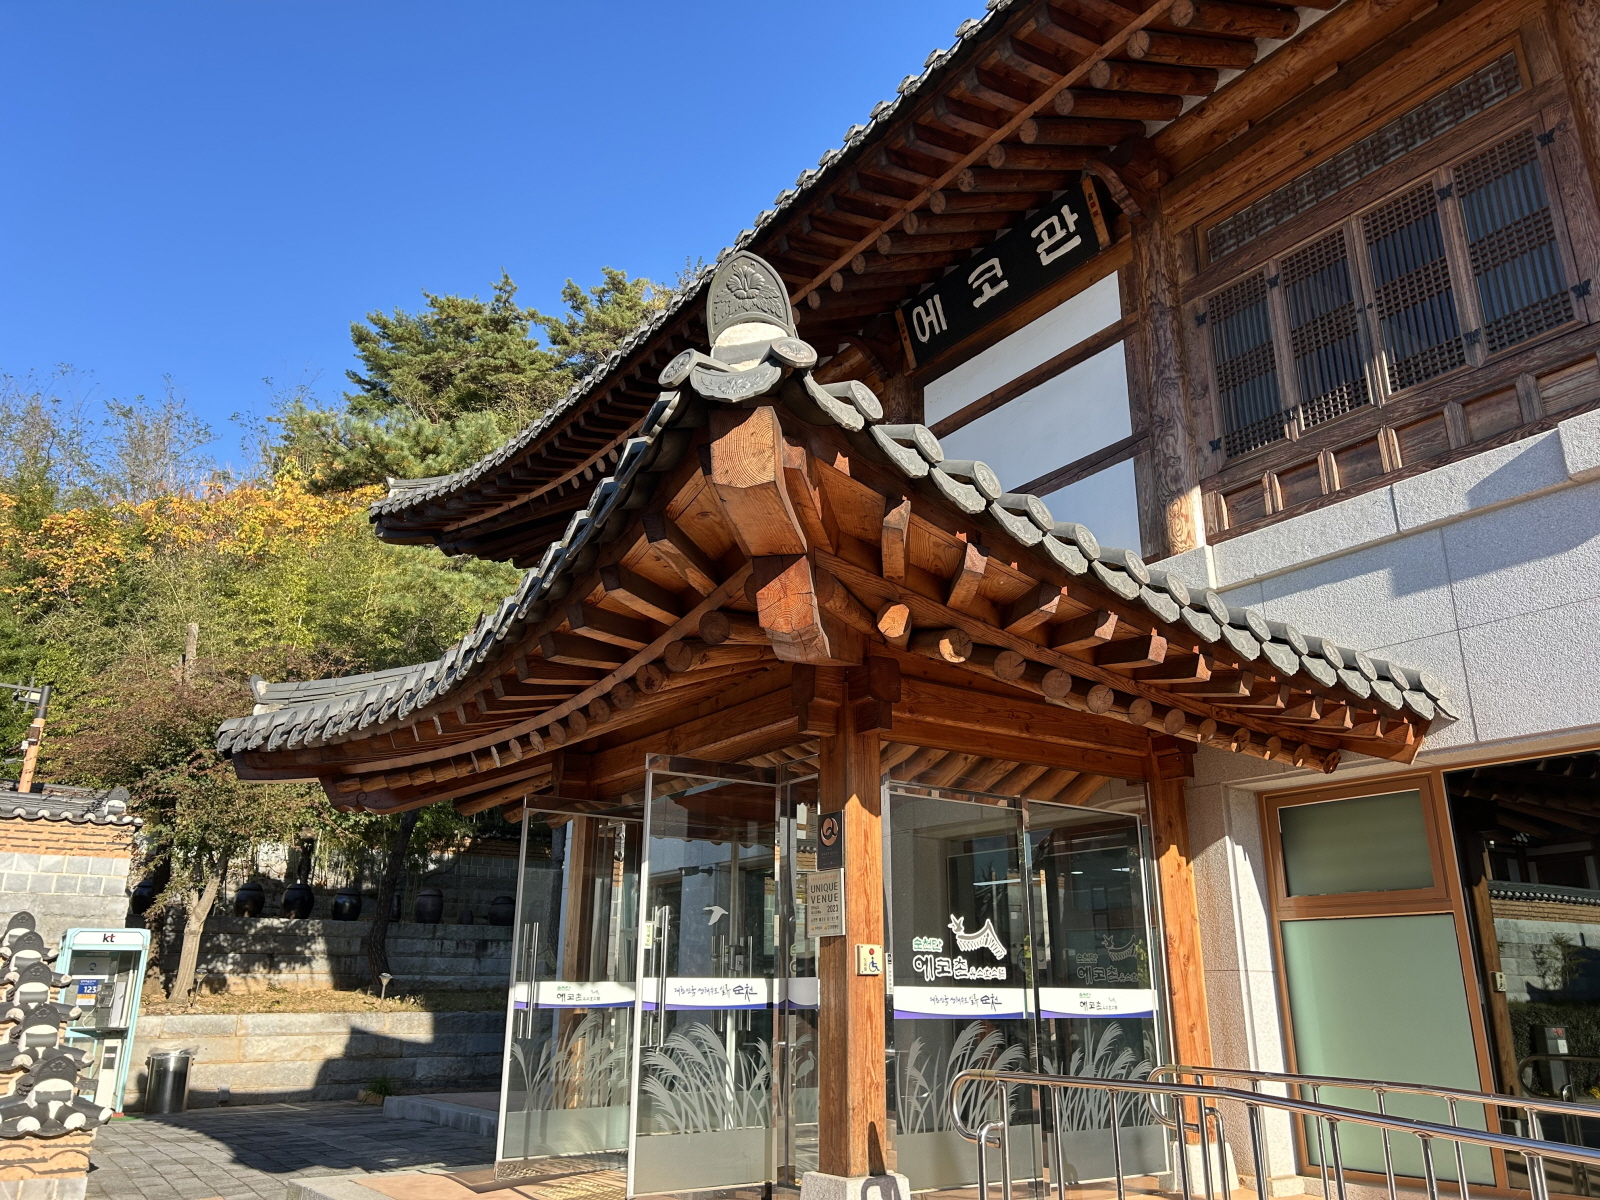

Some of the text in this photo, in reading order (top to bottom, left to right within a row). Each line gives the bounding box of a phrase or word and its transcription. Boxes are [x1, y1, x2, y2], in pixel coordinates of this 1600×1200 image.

[810, 882, 838, 894] UNIQUE
[810, 893, 838, 904] VENUE
[102, 933, 116, 943] kt
[913, 937, 943, 952] 순천만
[913, 955, 968, 981] 에코촌
[969, 966, 1006, 980] 유스호스텔
[1077, 965, 1118, 985] 에코촌
[83, 986, 97, 994] 123
[732, 983, 758, 1002] 순천
[980, 993, 1002, 1012] 순천
